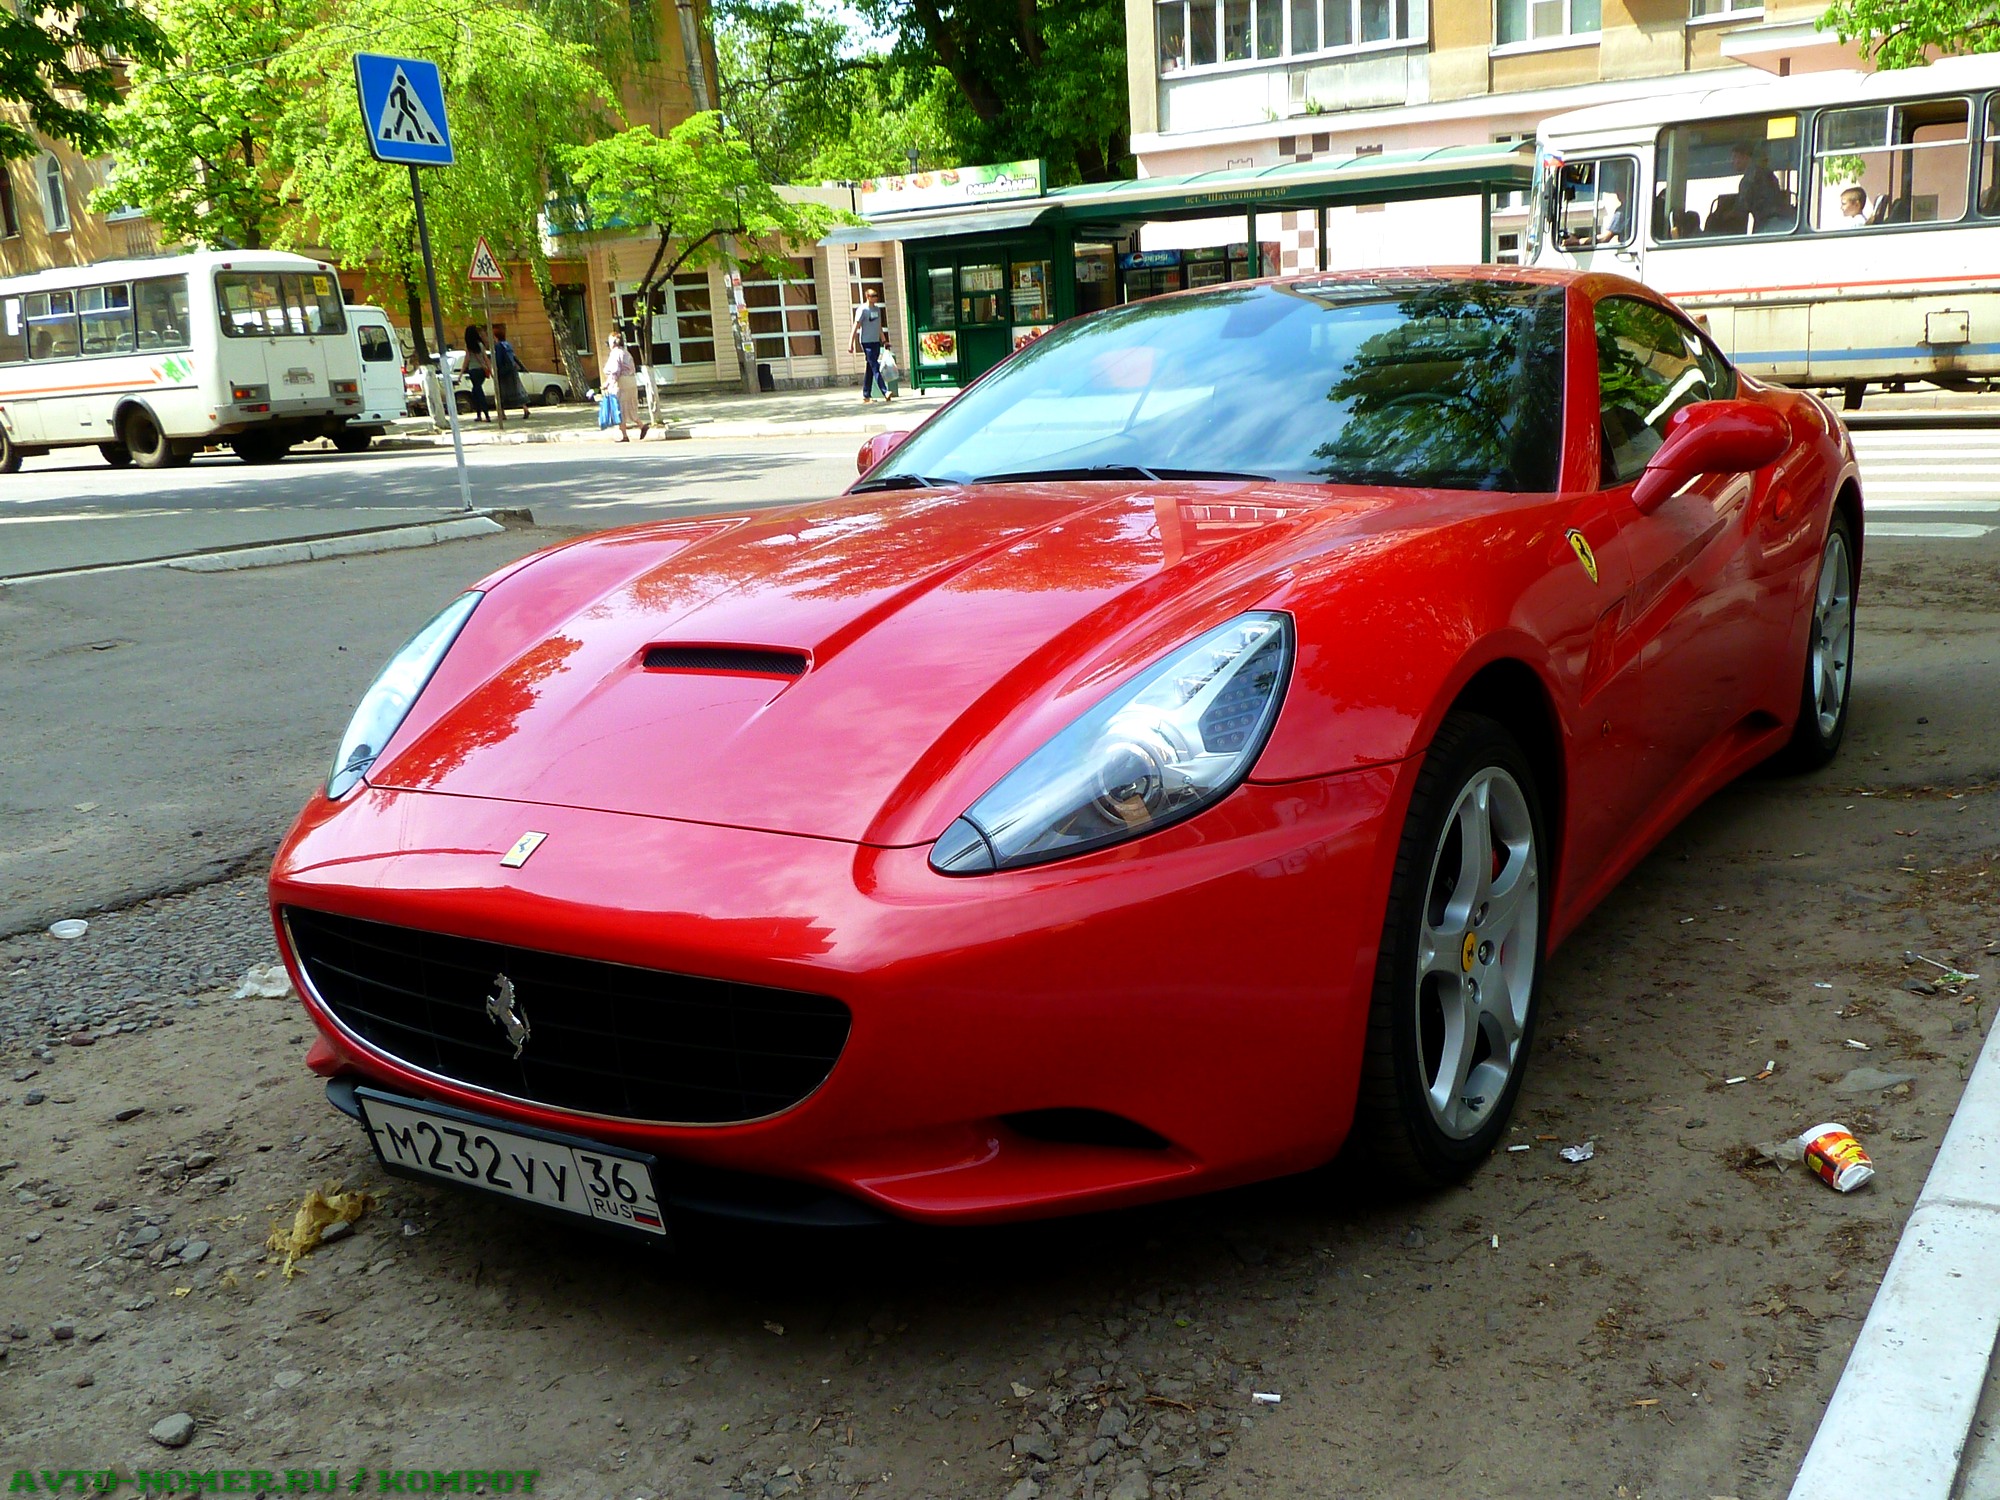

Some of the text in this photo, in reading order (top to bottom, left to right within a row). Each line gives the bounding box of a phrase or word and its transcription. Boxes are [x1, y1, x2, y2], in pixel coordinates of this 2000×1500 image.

[1144, 254, 1168, 263] PEPSI
[385, 1120, 567, 1202] М232УУ
[581, 1155, 637, 1204] 36
[593, 1197, 633, 1219] RUS
